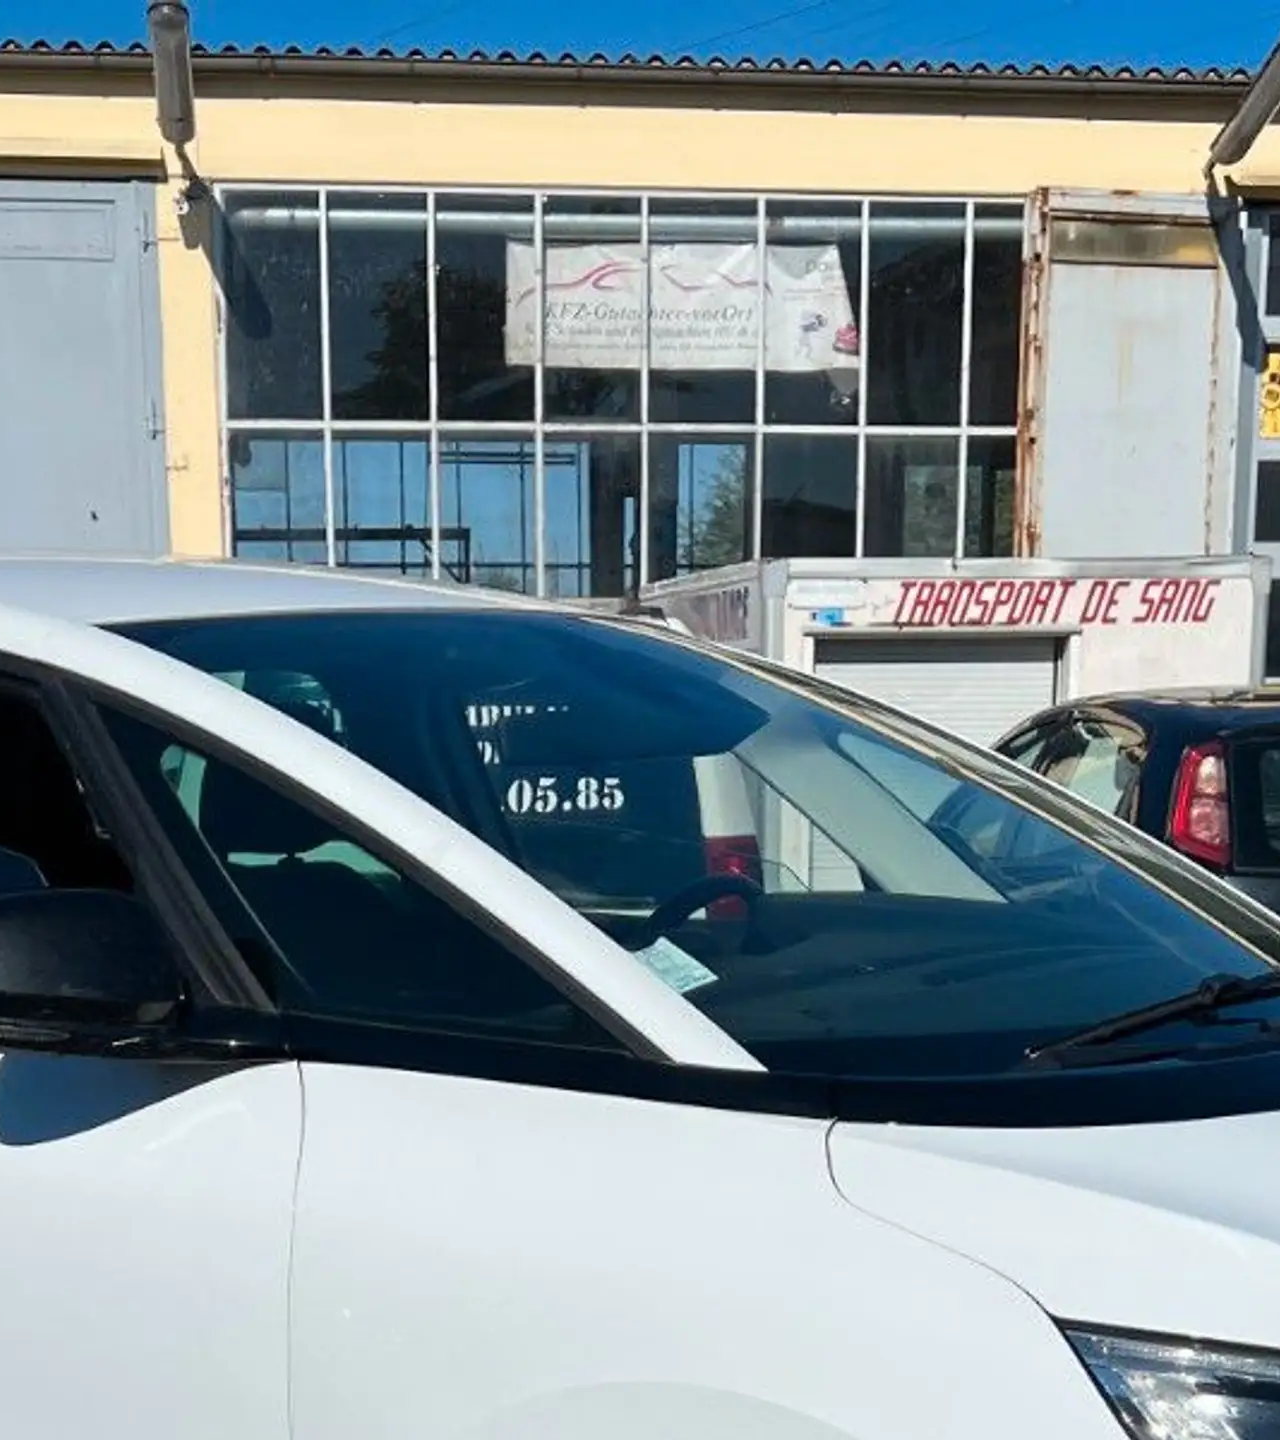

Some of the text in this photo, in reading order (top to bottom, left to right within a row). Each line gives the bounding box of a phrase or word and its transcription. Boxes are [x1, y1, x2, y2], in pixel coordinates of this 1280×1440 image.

[894, 579, 1221, 627] TRANSPORT DE SANG
